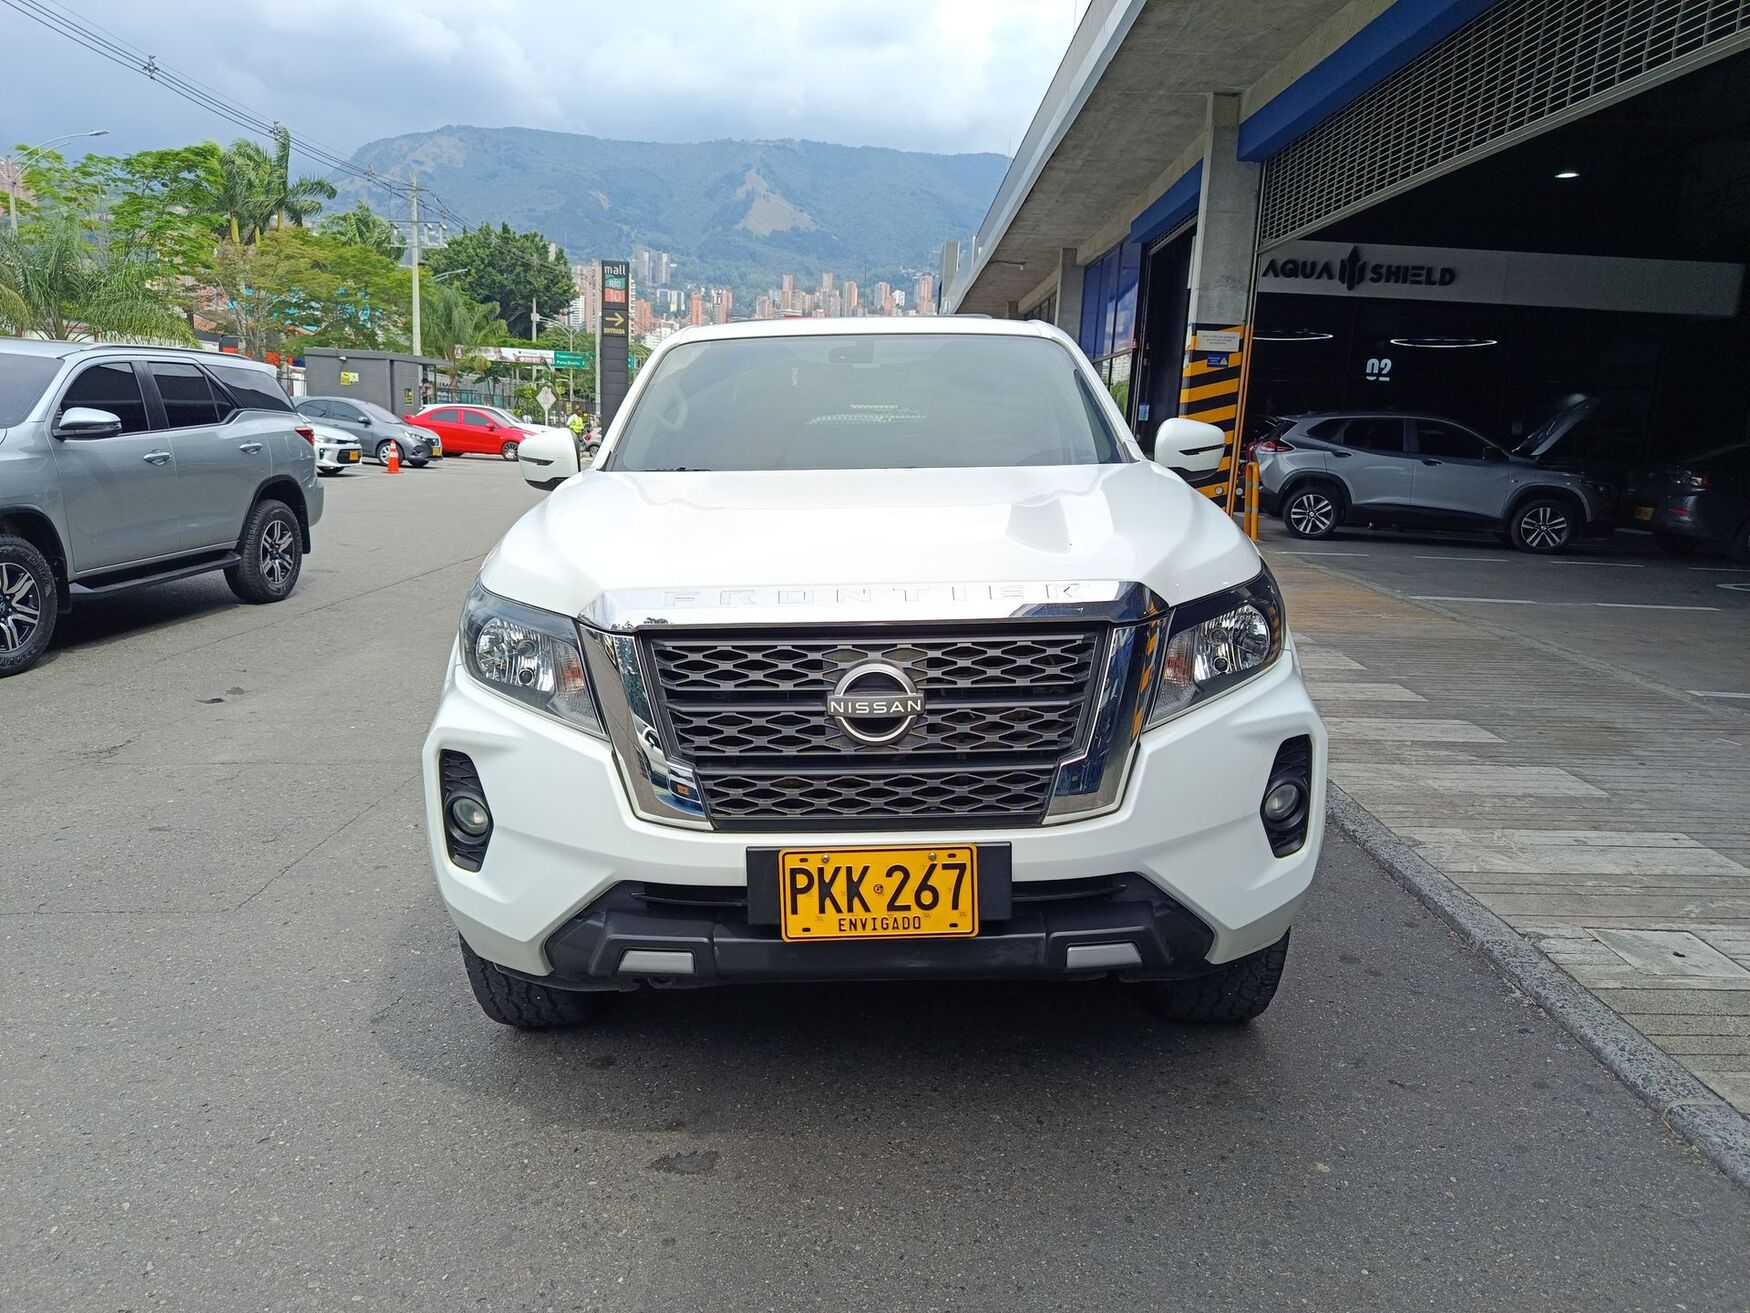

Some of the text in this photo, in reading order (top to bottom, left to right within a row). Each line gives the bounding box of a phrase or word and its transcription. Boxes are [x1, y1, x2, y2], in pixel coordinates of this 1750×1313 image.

[604, 264, 626, 275] mall
[1261, 258, 1456, 287] AQUA SHIELD
[1365, 358, 1392, 381] 02
[664, 583, 1090, 607] FRONTIER
[830, 698, 922, 714] NISSAN
[789, 862, 967, 915] PKK 267
[838, 915, 922, 932] ENVIGADO
